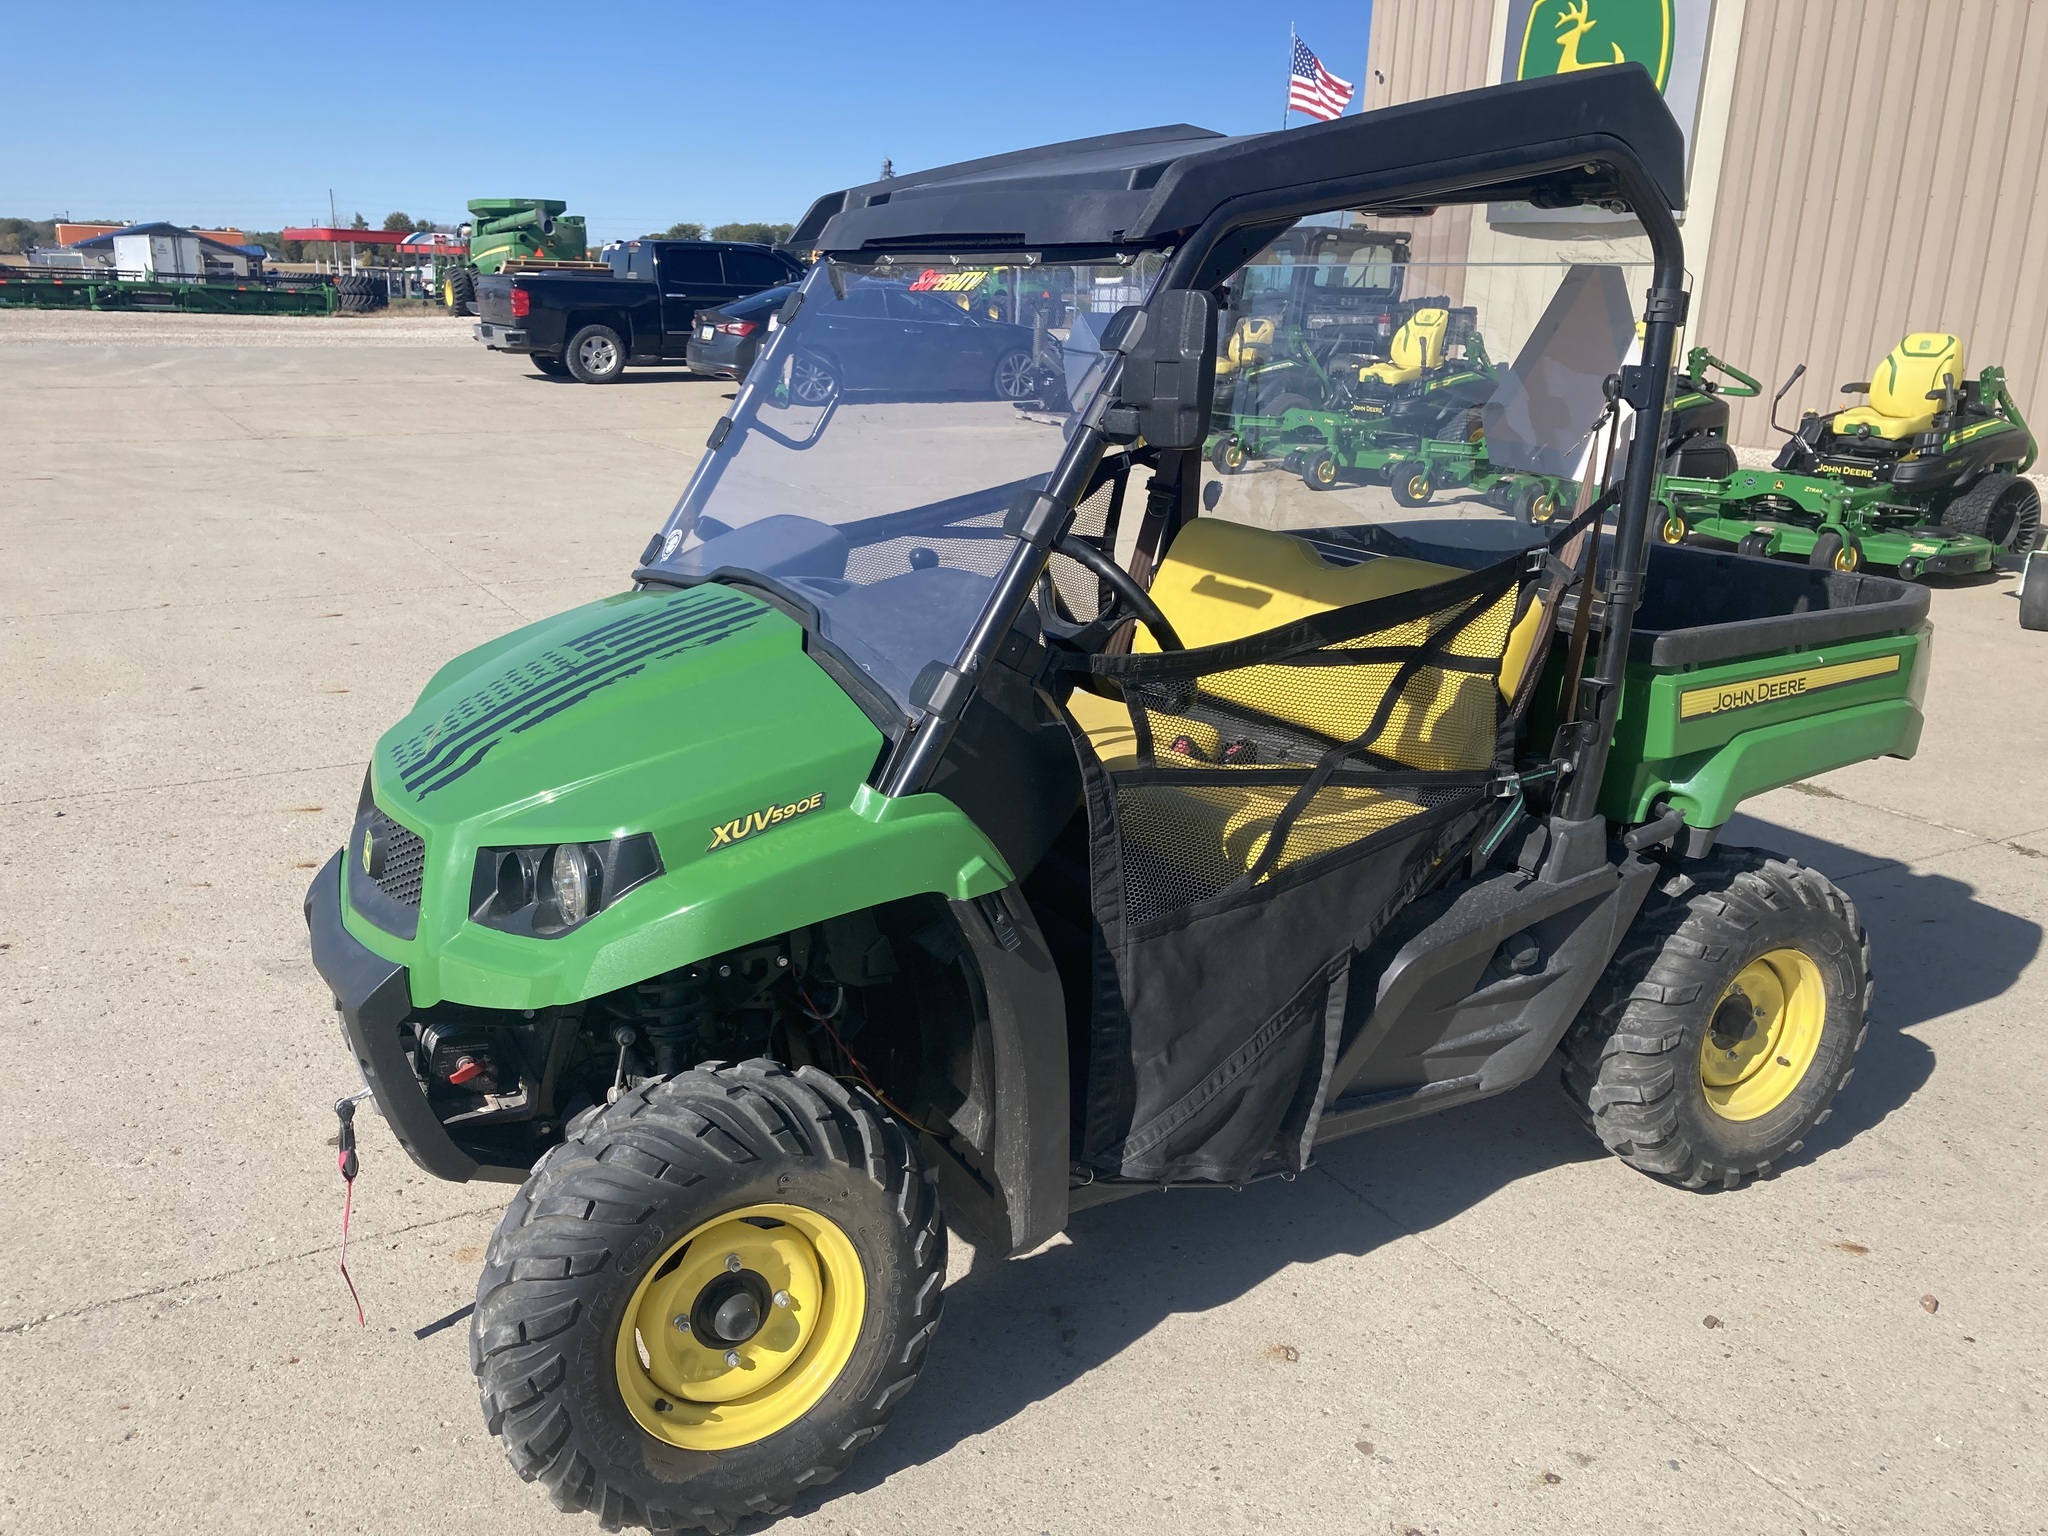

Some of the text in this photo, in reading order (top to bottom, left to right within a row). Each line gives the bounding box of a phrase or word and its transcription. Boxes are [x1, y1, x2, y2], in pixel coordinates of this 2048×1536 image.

[1352, 404, 1383, 413] JOHN DEERE
[1817, 463, 1874, 478] JOHN DEERE
[1712, 677, 1807, 711] JOHN DEERE
[709, 793, 823, 849] XUV590E
